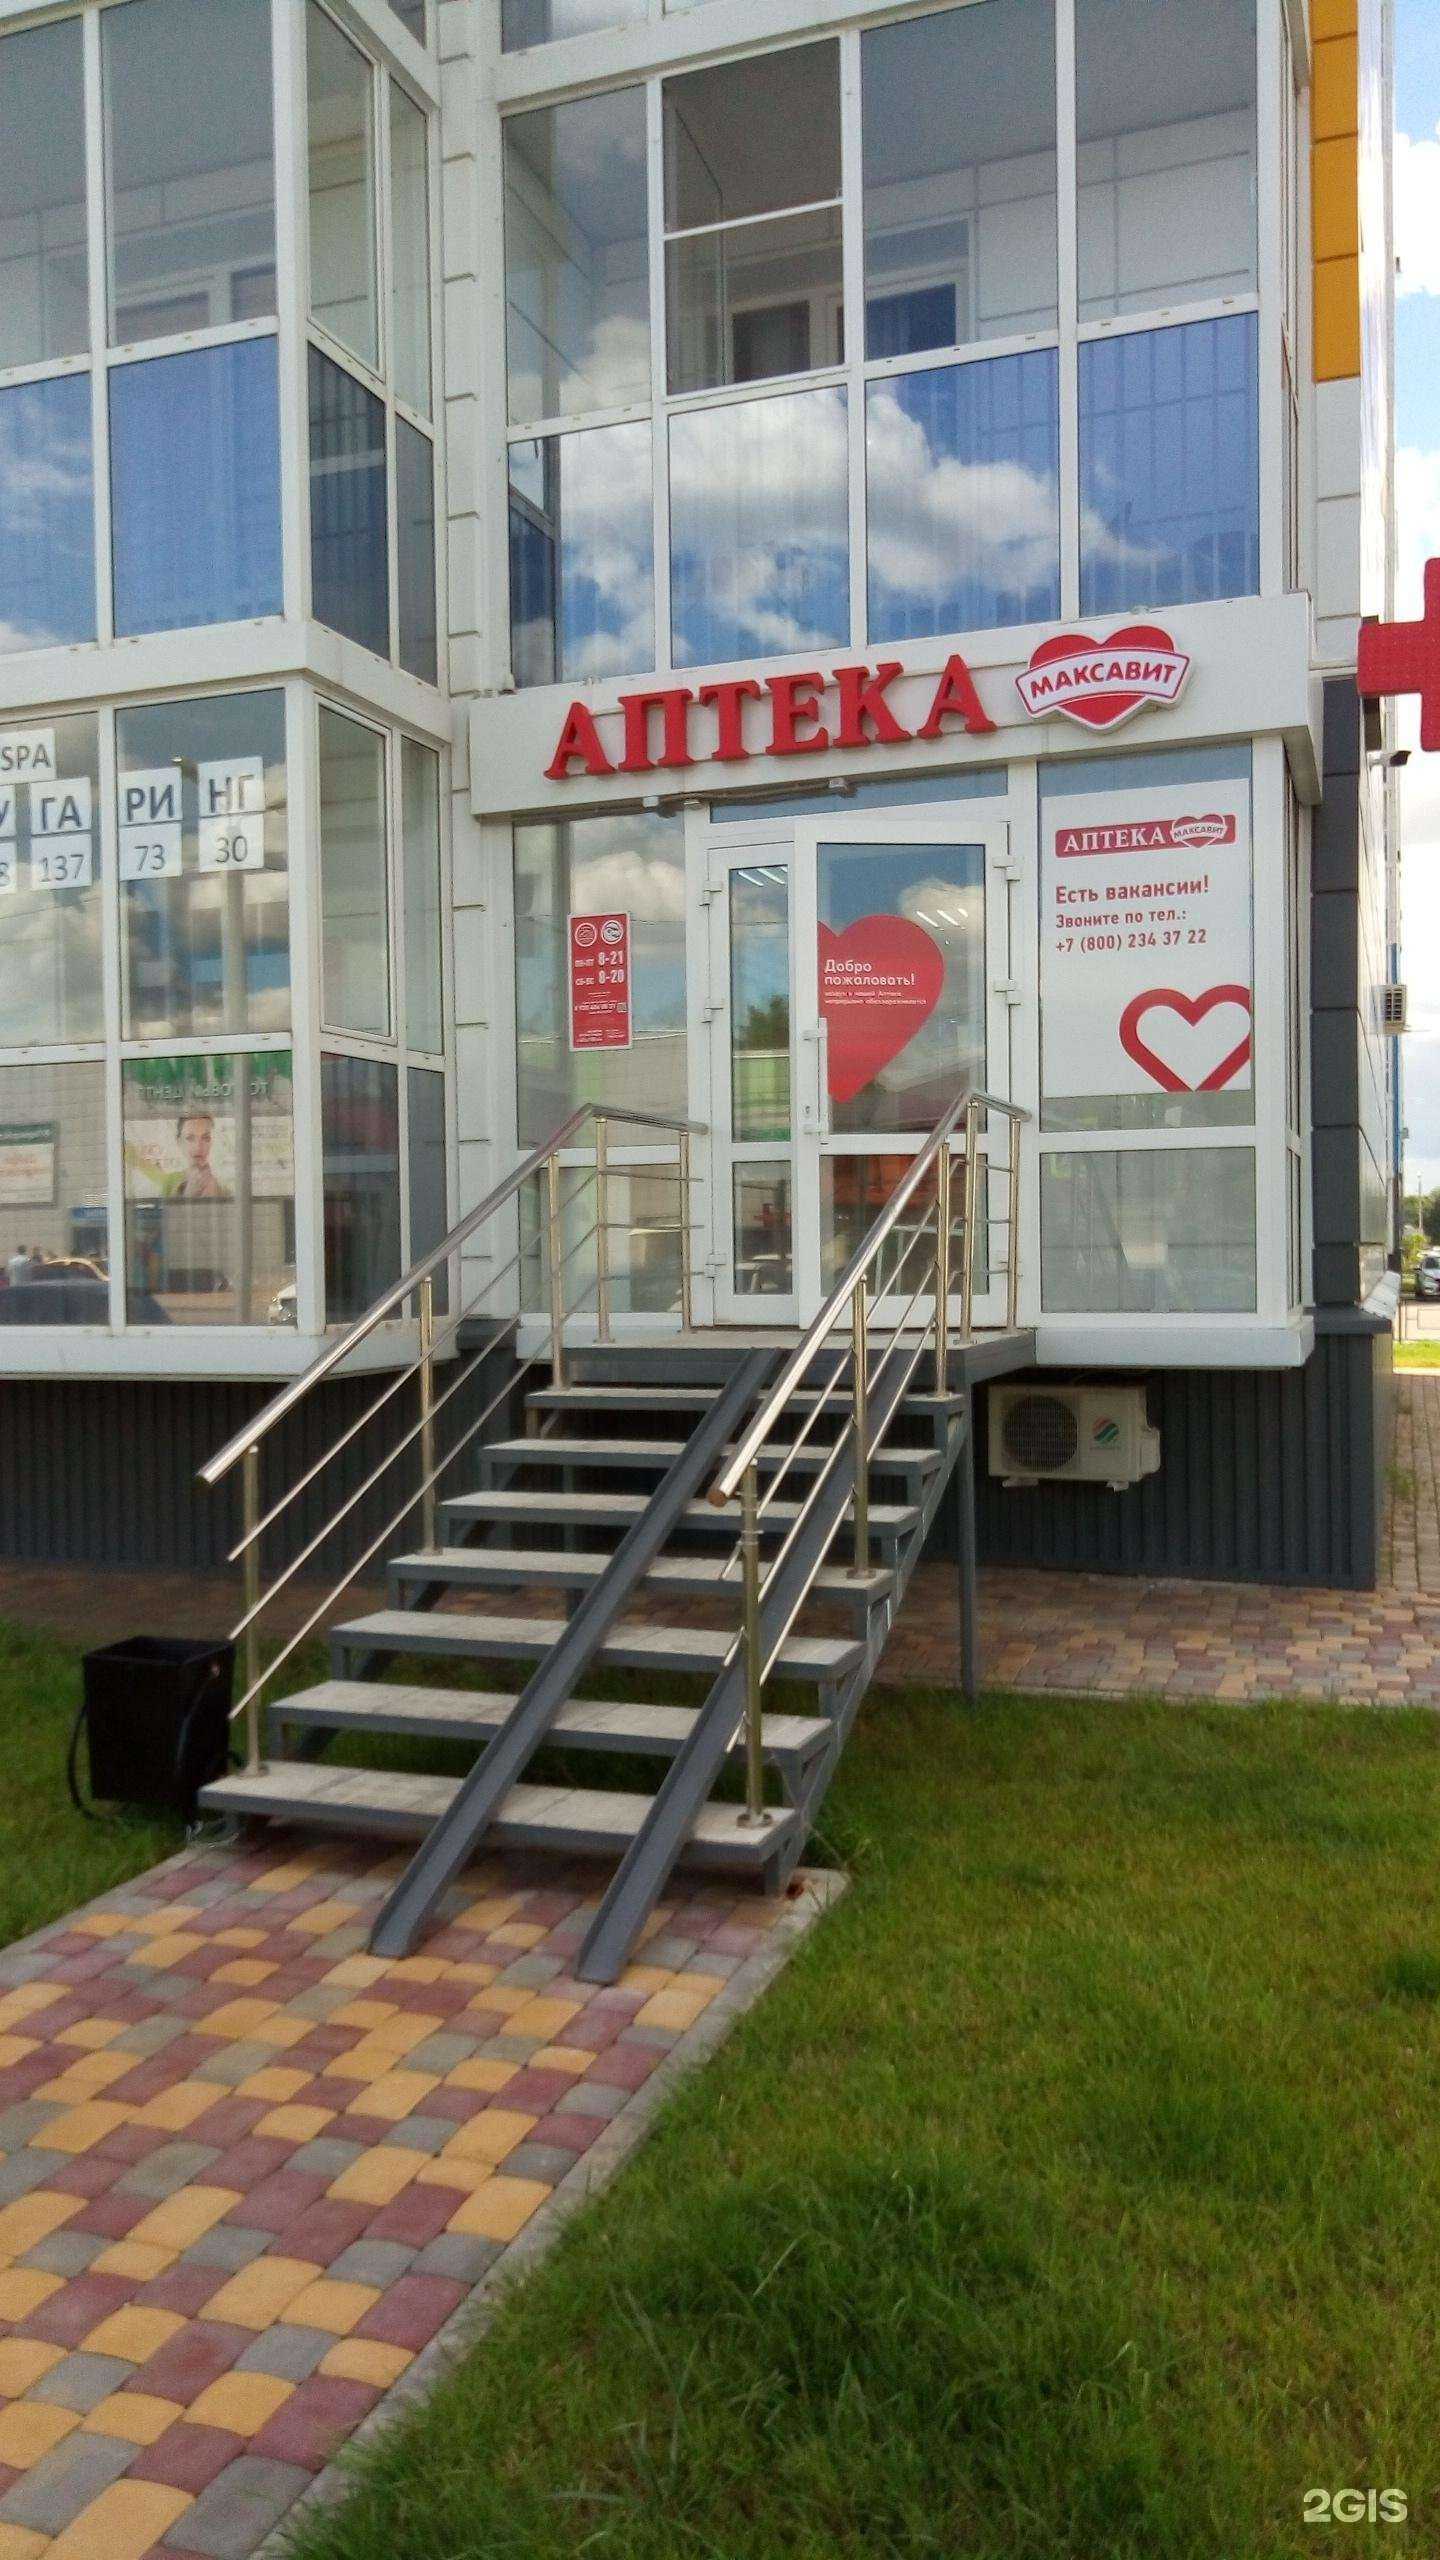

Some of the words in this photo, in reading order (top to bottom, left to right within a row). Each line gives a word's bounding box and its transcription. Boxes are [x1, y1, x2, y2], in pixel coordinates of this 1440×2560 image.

[1029, 661, 1177, 699] МАКСАВИТ
[543, 654, 998, 781] АПТЕКА
[1063, 826, 1166, 853] АПТЕКА
[40, 853, 85, 883] 137
[135, 844, 167, 873] 73
[215, 834, 248, 864] 30
[1055, 885, 1099, 904] Есть
[1105, 874, 1209, 901] вакансии!
[1055, 913, 1120, 929] Звоните
[1125, 911, 1144, 924] по
[1149, 909, 1187, 922] тел.:
[1055, 937, 1074, 953] +7
[1080, 934, 1122, 954] (800)
[1128, 932, 1156, 949] 234
[1163, 930, 1181, 946] 37
[1187, 929, 1207, 944] 22
[824, 959, 872, 974] Добро
[824, 973, 916, 986] пожаловать!
